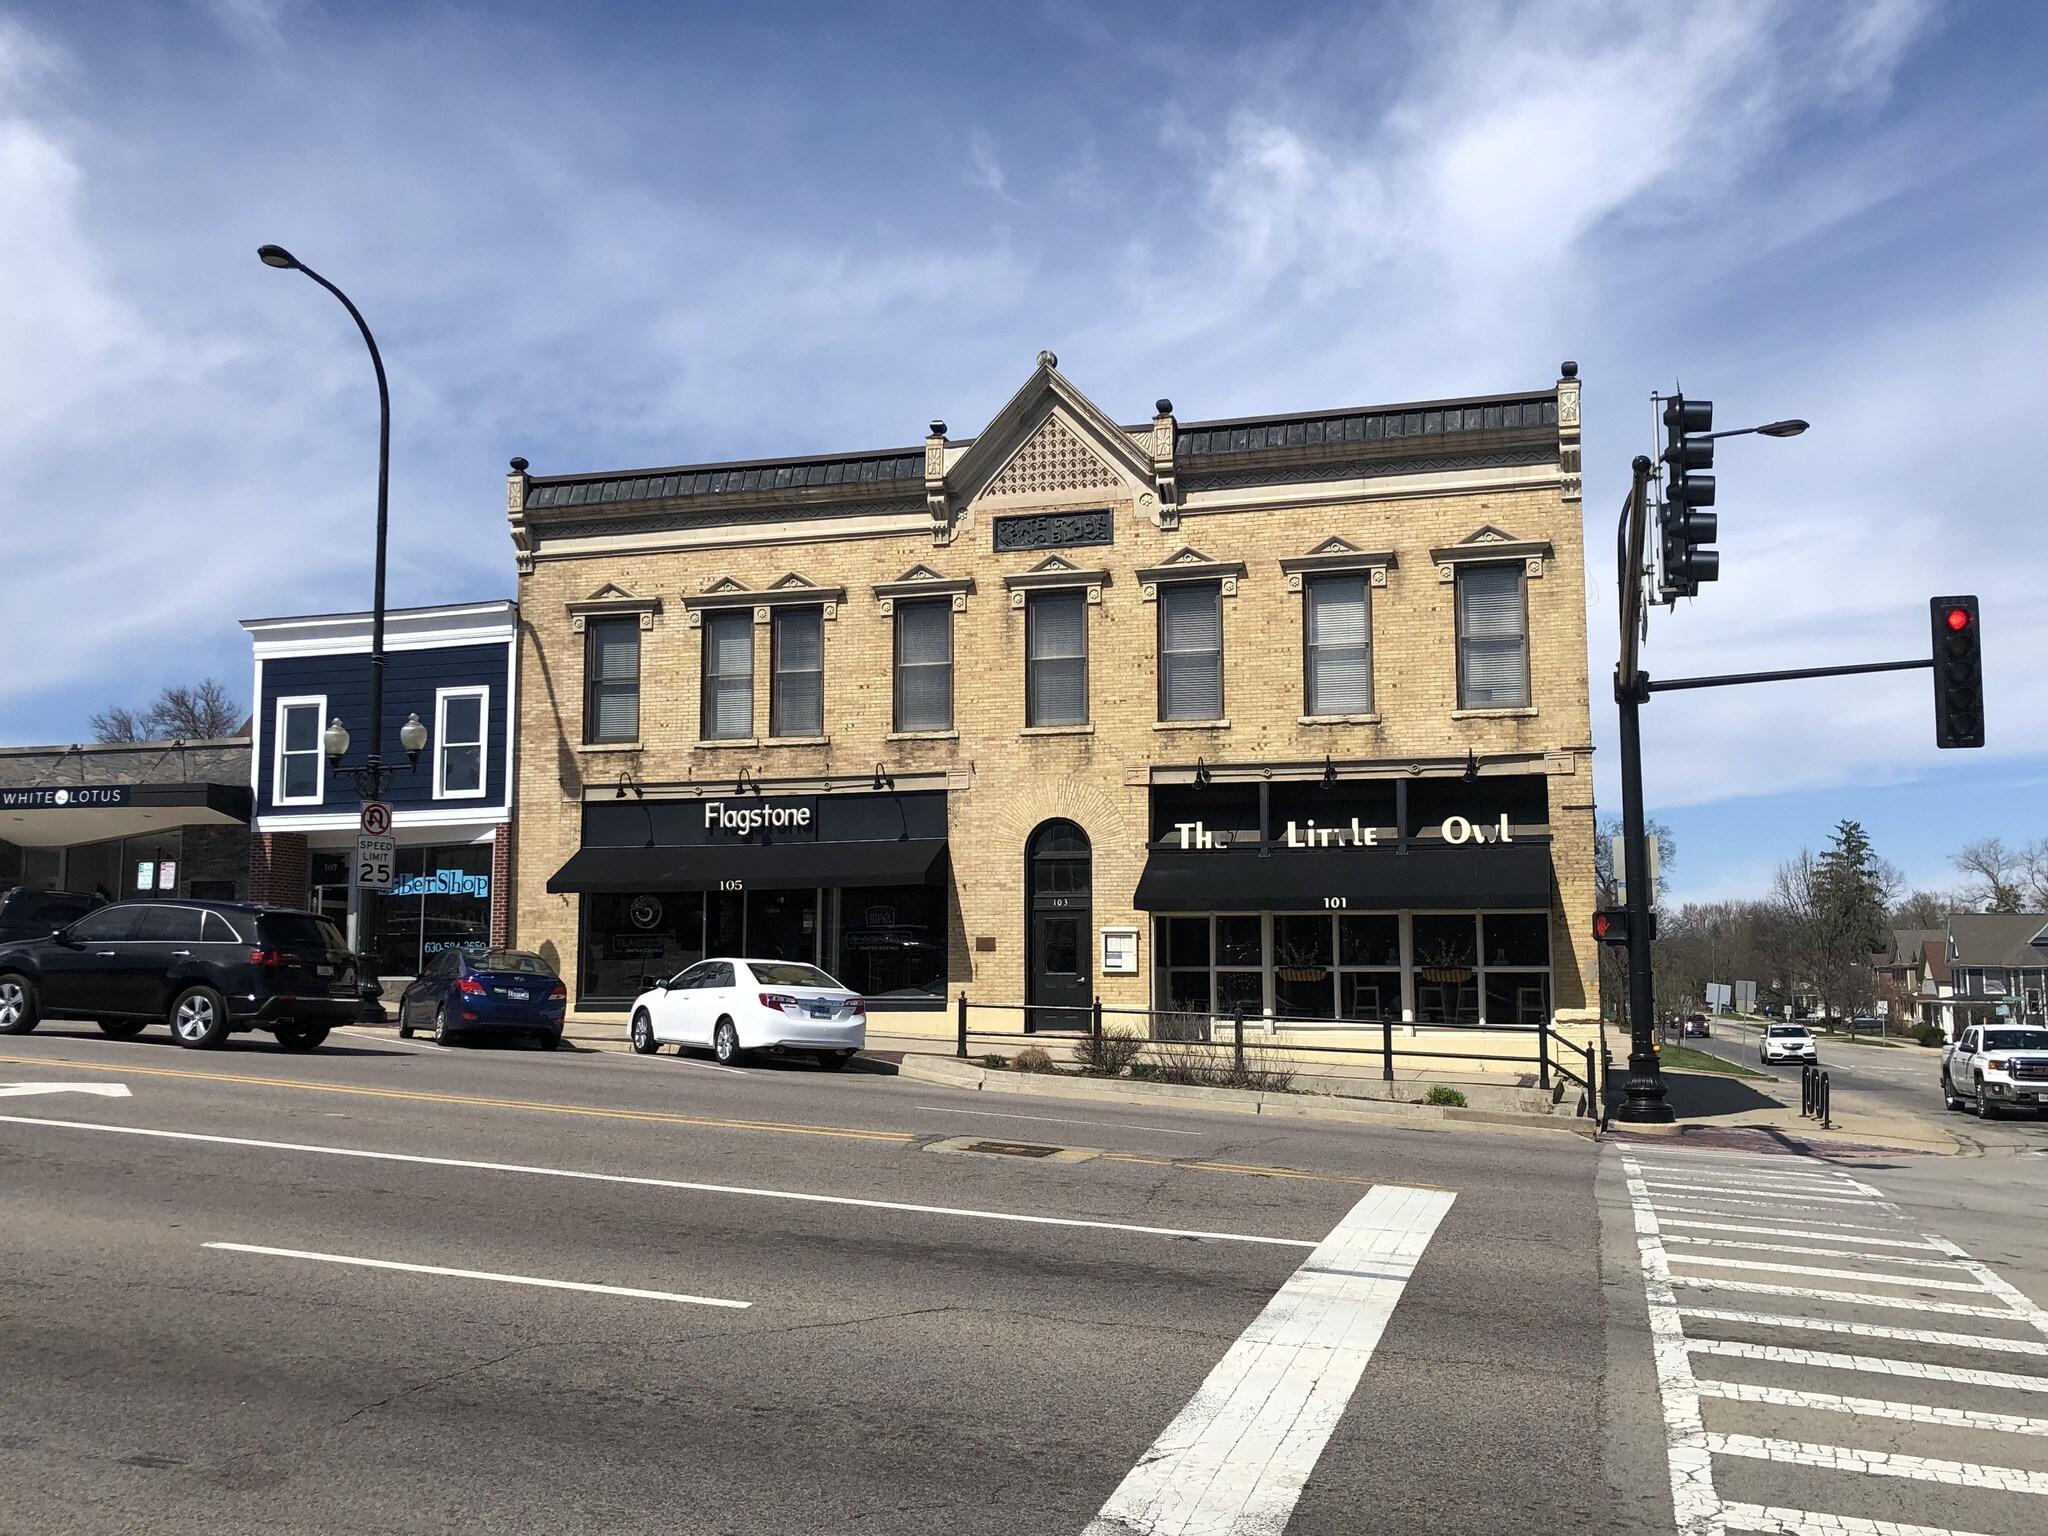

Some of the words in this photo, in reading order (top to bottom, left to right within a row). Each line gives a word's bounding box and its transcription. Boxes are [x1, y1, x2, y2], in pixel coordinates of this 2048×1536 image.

[3, 791, 54, 804] WHITE
[69, 789, 121, 803] LOTUS
[704, 801, 811, 835] Flagstone
[1174, 820, 1228, 849] The
[1441, 813, 1513, 845] Owl
[360, 840, 392, 851] SPEED
[363, 853, 389, 861] LIMIT
[324, 863, 338, 872] 107
[360, 863, 390, 883] 25
[719, 880, 743, 891] 105
[1053, 898, 1068, 907] 103
[1323, 896, 1347, 909] 101
